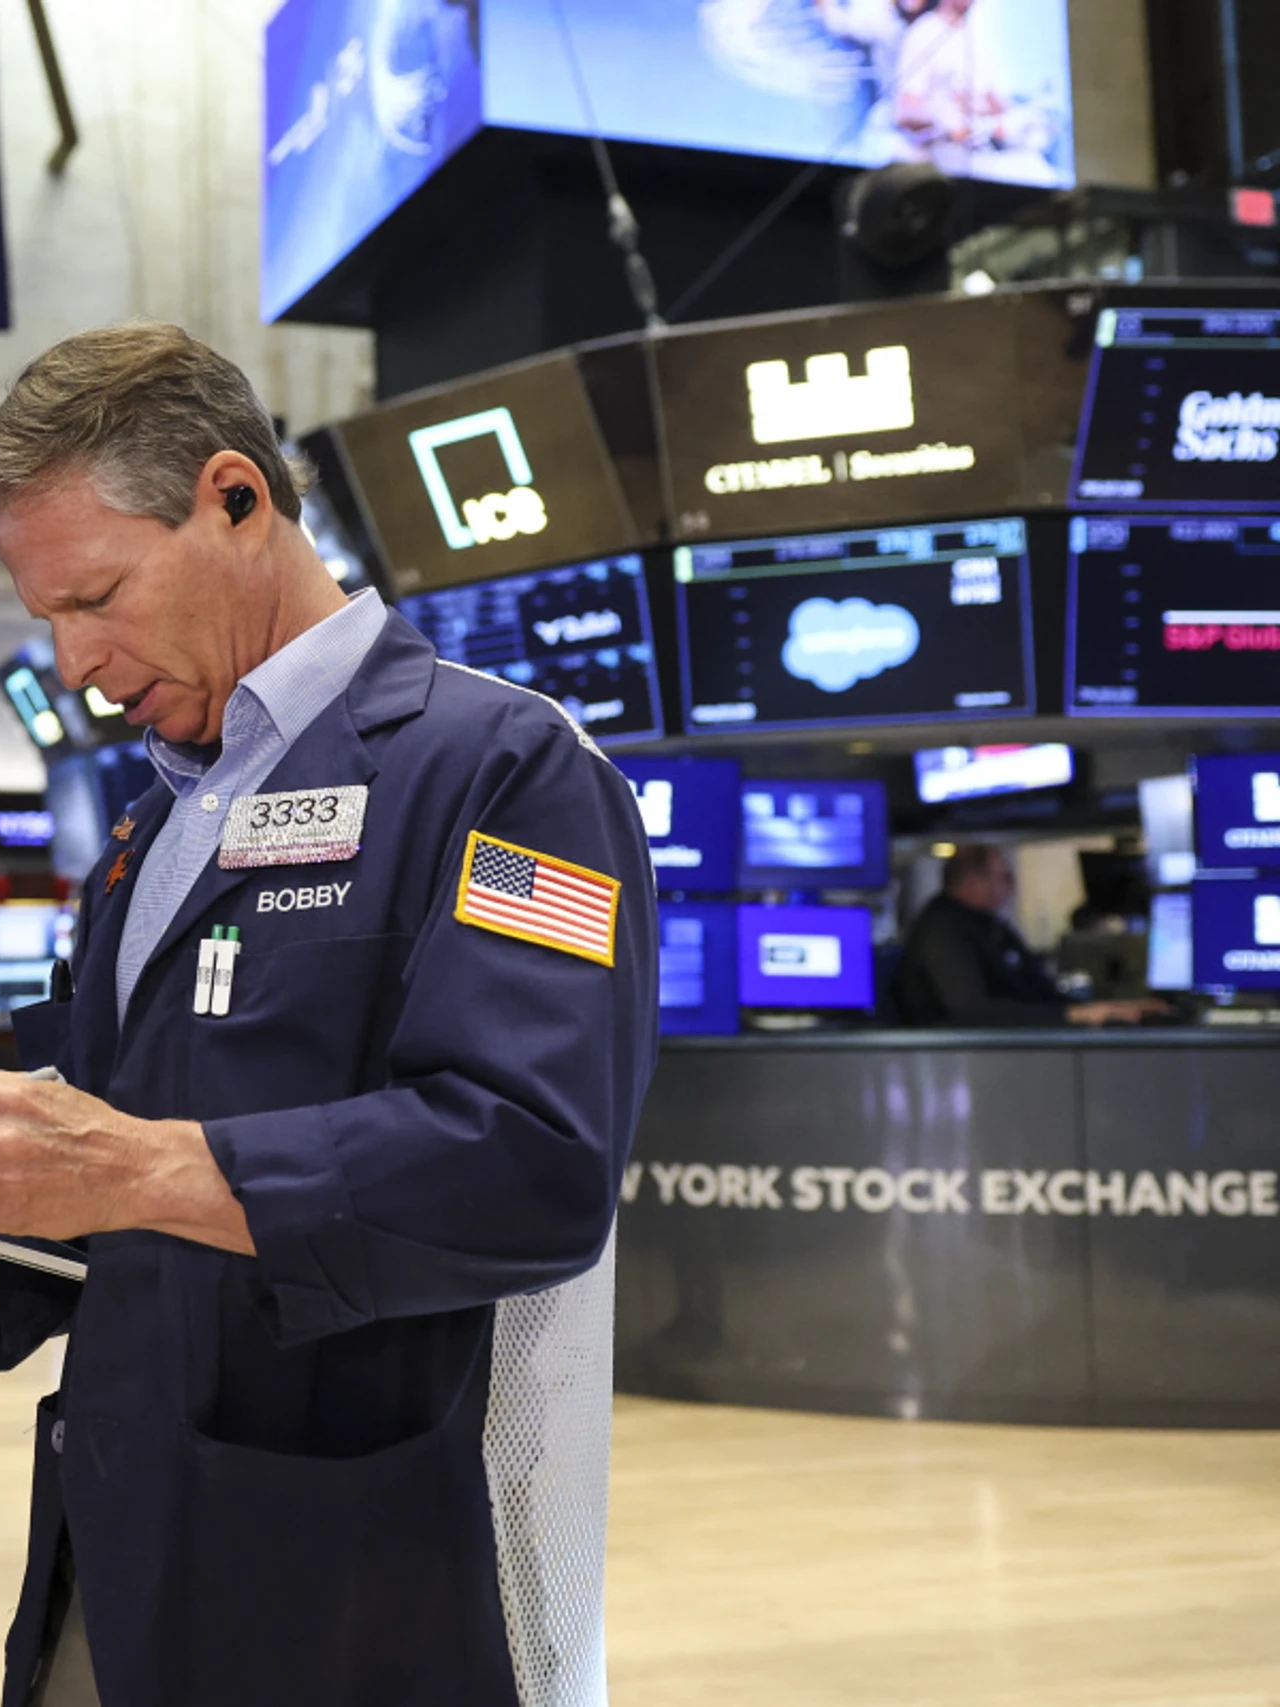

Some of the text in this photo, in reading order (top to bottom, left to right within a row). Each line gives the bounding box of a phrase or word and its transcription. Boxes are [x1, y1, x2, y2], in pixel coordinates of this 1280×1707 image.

[250, 795, 339, 829] 3333
[256, 881, 352, 913] BOBBY
[649, 1161, 783, 1208] YORK
[789, 1165, 971, 1215] STOCK
[979, 1168, 1280, 1217] EXCHANGE
